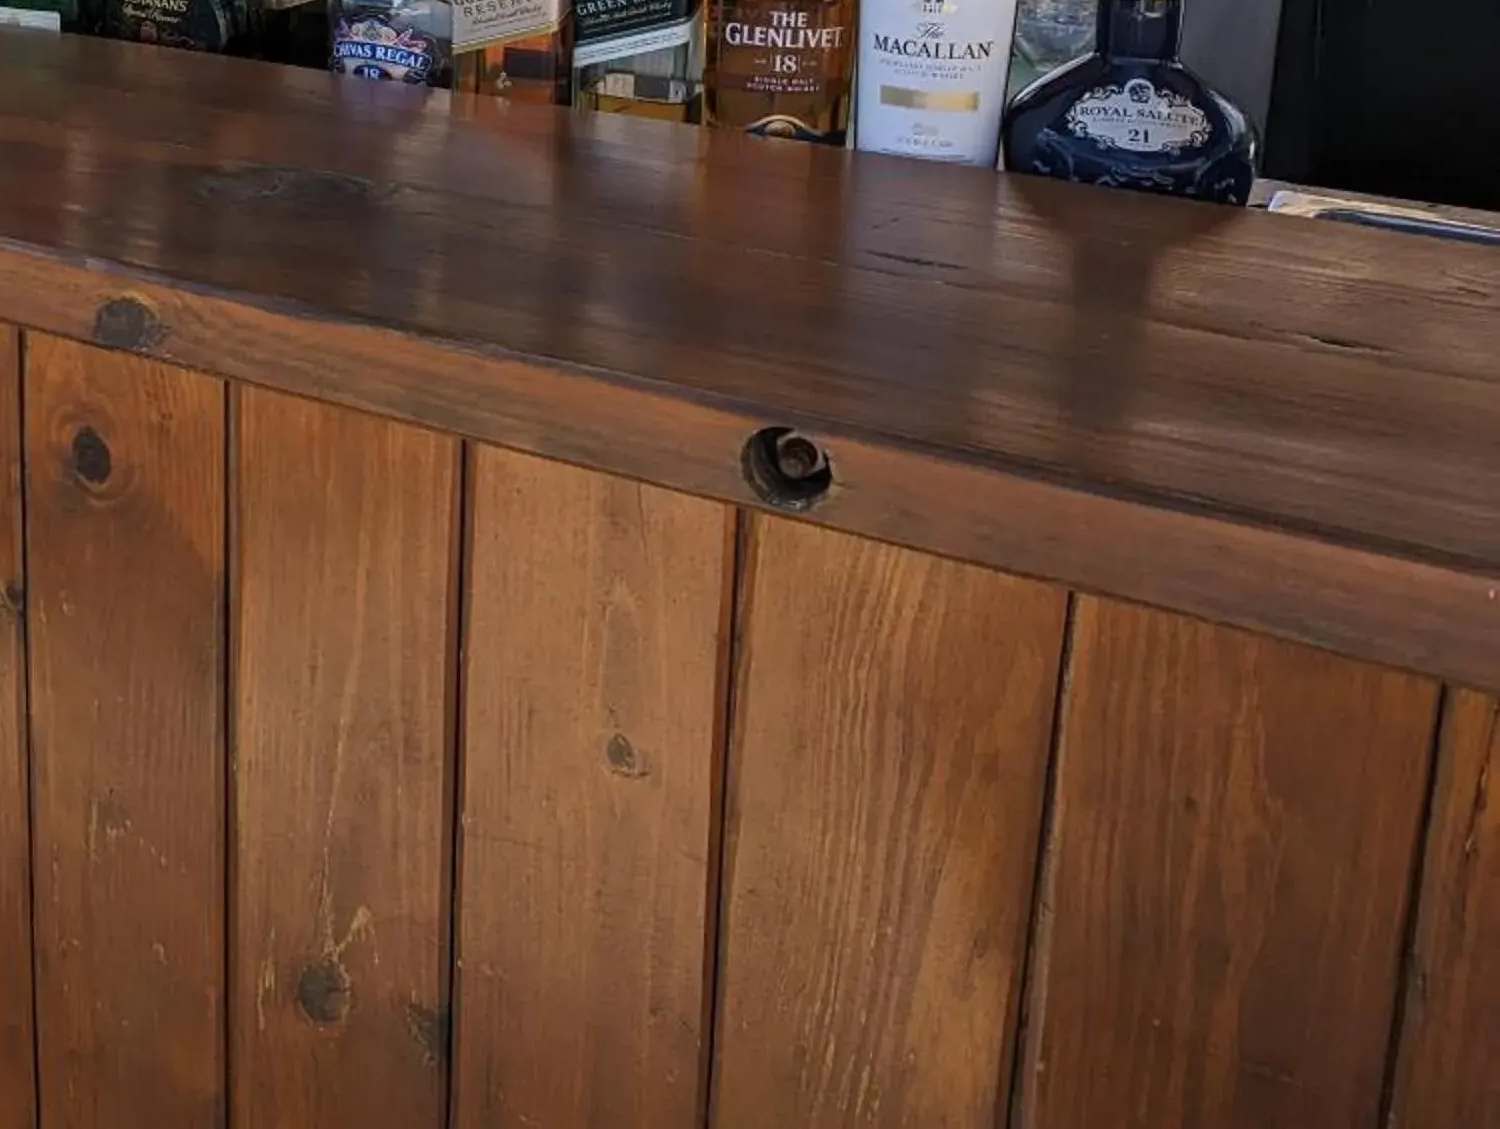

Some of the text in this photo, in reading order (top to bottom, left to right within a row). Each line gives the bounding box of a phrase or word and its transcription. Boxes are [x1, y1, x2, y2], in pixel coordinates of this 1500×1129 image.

[769, 10, 809, 28] THE
[725, 22, 844, 48] GLENLIVET
[873, 33, 994, 60] MACALLAN
[375, 45, 426, 70] REGAL
[773, 54, 798, 73] 18
[1080, 105, 1132, 118] ROYAL
[1128, 128, 1150, 144] 21
